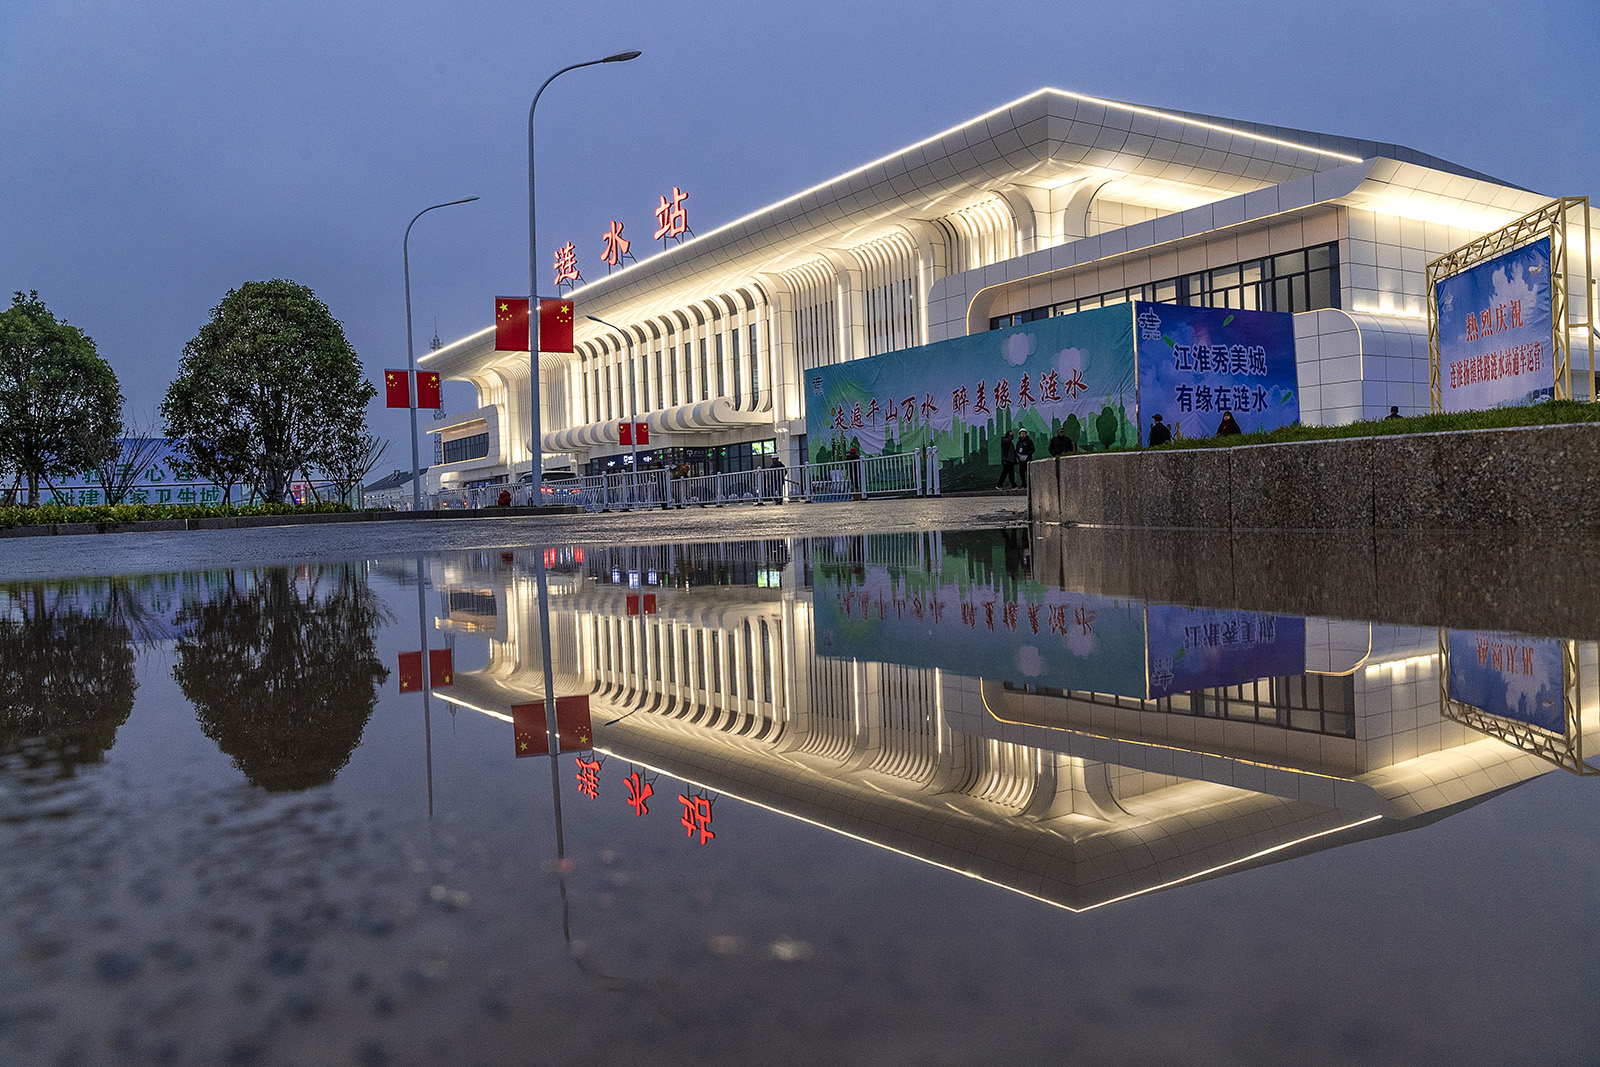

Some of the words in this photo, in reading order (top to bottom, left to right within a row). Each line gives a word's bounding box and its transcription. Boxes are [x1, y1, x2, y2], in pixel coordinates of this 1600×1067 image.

[553, 187, 689, 285] 涟水站
[1465, 299, 1524, 342] 热烈庆祝
[1173, 344, 1268, 376] 江淮秀美城
[833, 392, 939, 432] 走遍千山万水
[951, 367, 1089, 420] 醉美缘来涟水
[1175, 384, 1269, 413] 有缘在涟水
